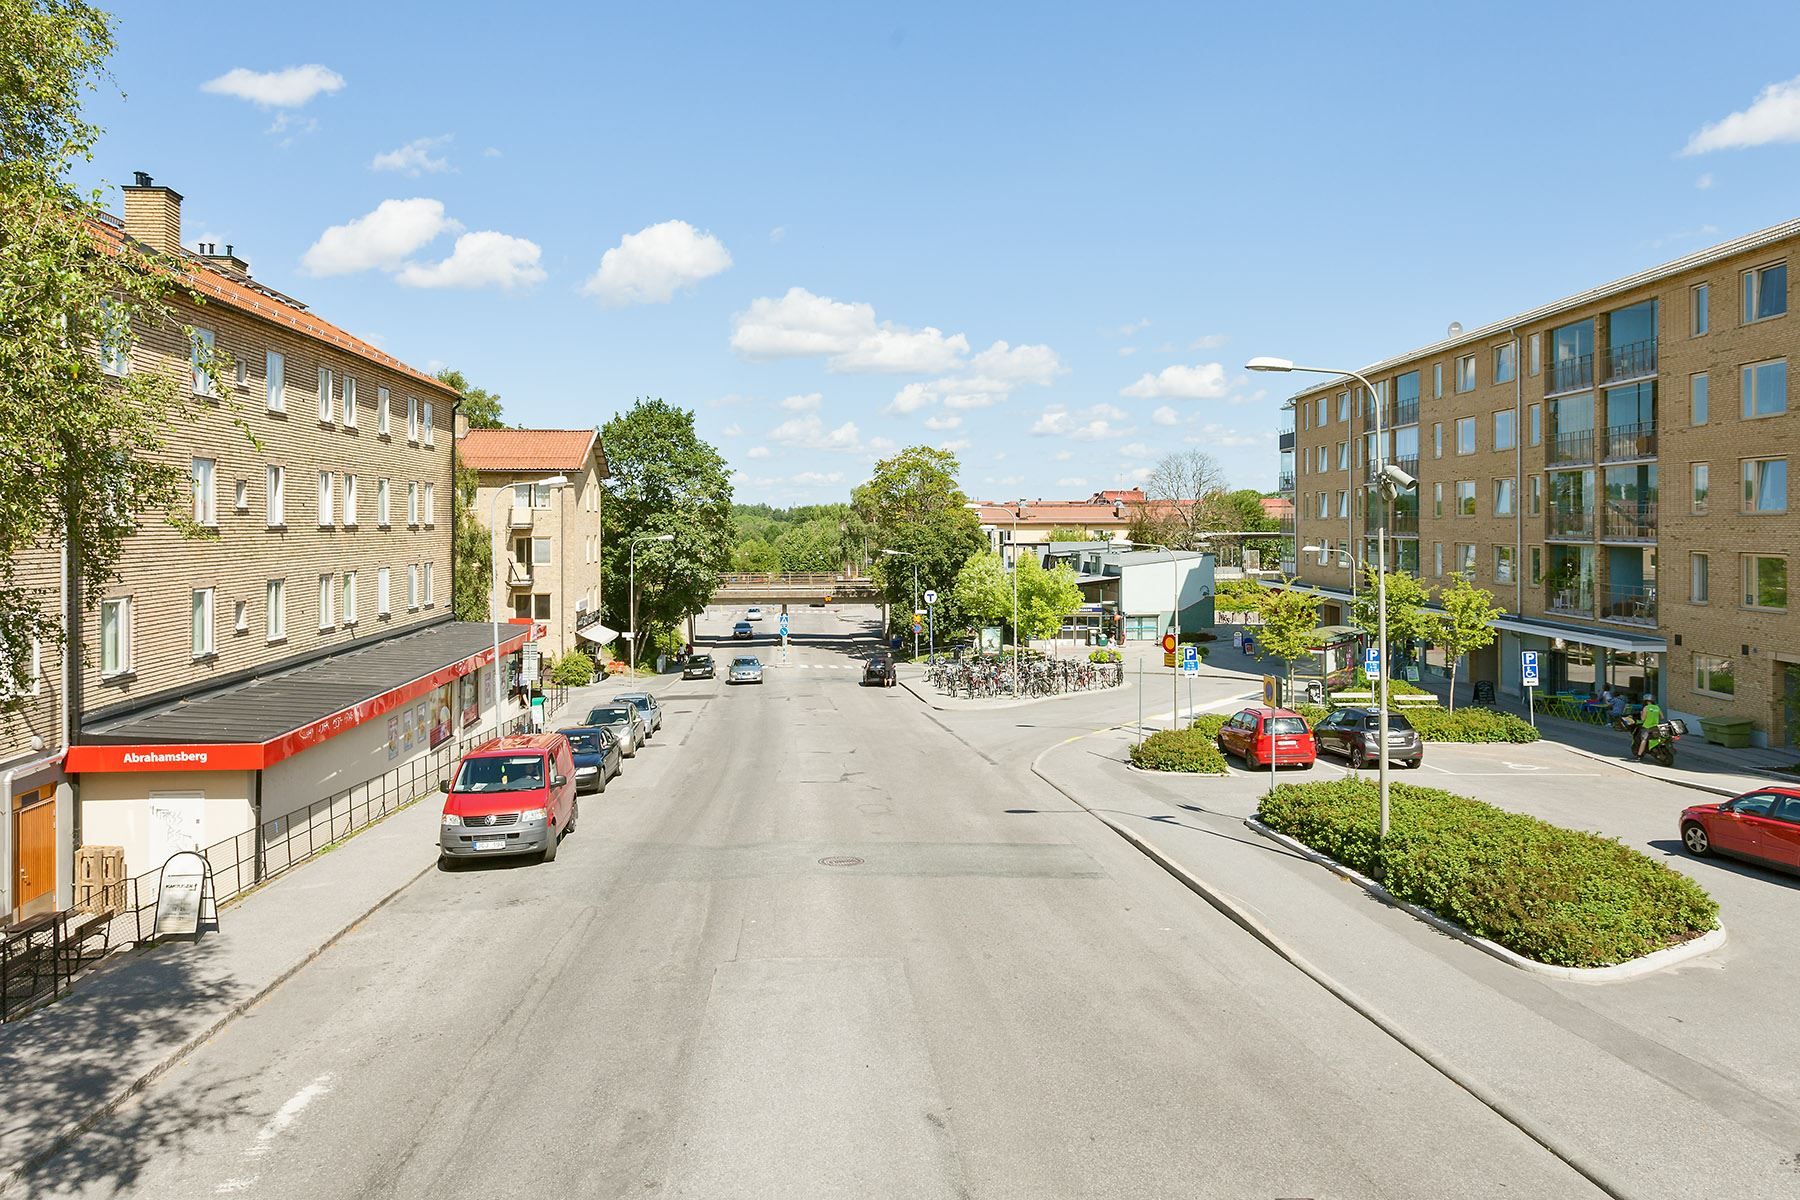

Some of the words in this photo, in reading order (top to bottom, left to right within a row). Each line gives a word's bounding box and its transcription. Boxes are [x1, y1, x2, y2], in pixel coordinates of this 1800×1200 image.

[927, 593, 934, 602] T
[1186, 649, 1194, 659] P
[1370, 650, 1378, 660] P
[1526, 653, 1534, 664] P
[123, 751, 208, 763] Abrahamsberg
